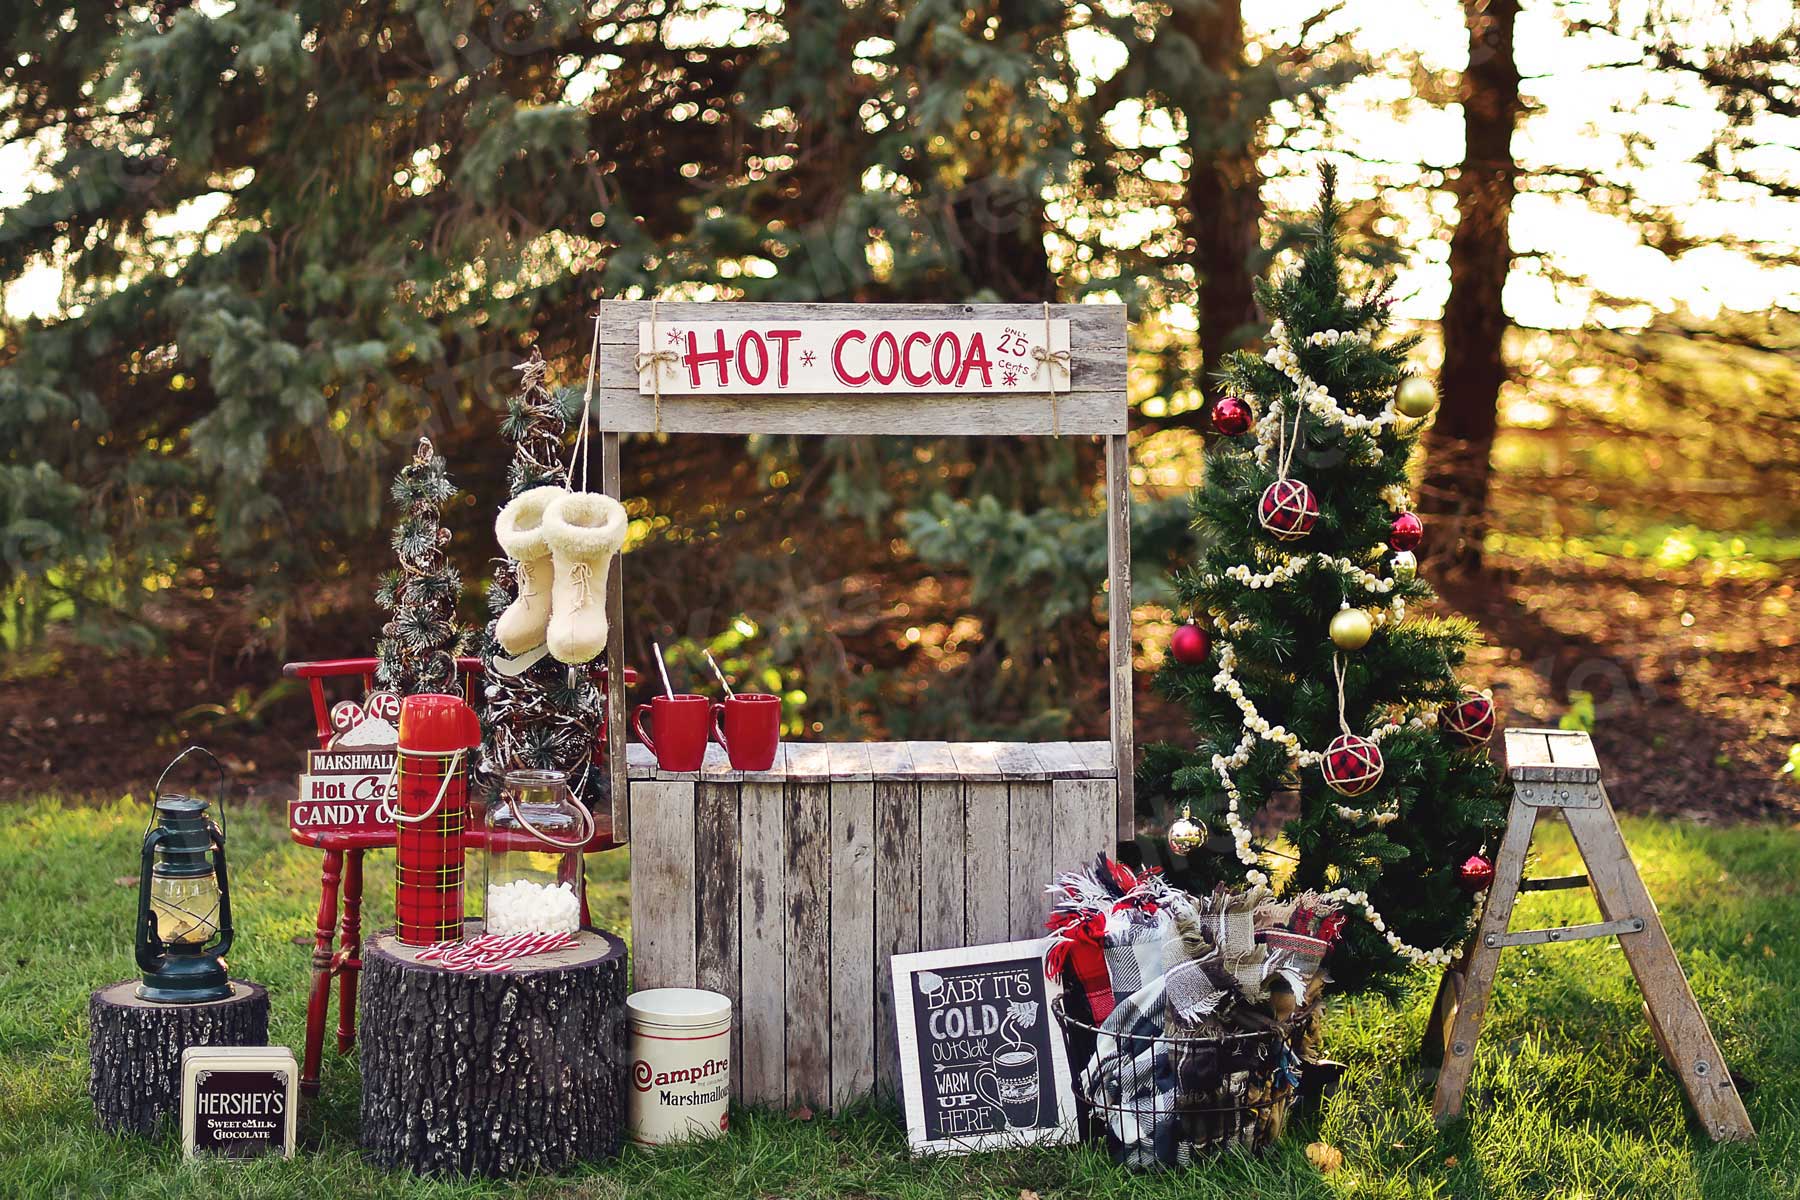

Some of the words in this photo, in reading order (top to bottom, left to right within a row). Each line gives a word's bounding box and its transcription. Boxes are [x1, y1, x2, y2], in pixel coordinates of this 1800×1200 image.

[1004, 327, 1027, 337] ONLY
[997, 334, 1029, 357] 25
[682, 329, 802, 388] HOT
[831, 329, 992, 388] COCOA
[997, 359, 1029, 374] cents
[312, 781, 345, 799] Hot
[294, 804, 369, 825] CANDY
[927, 977, 985, 1009] BABY
[993, 973, 1031, 999] IT'S
[929, 1004, 1000, 1039] COLD
[632, 1059, 728, 1092] Campfire
[934, 1071, 970, 1094] WARM
[198, 1090, 284, 1114] HERSHEY'S
[937, 1094, 977, 1107] UP
[938, 1106, 994, 1132] HERE
